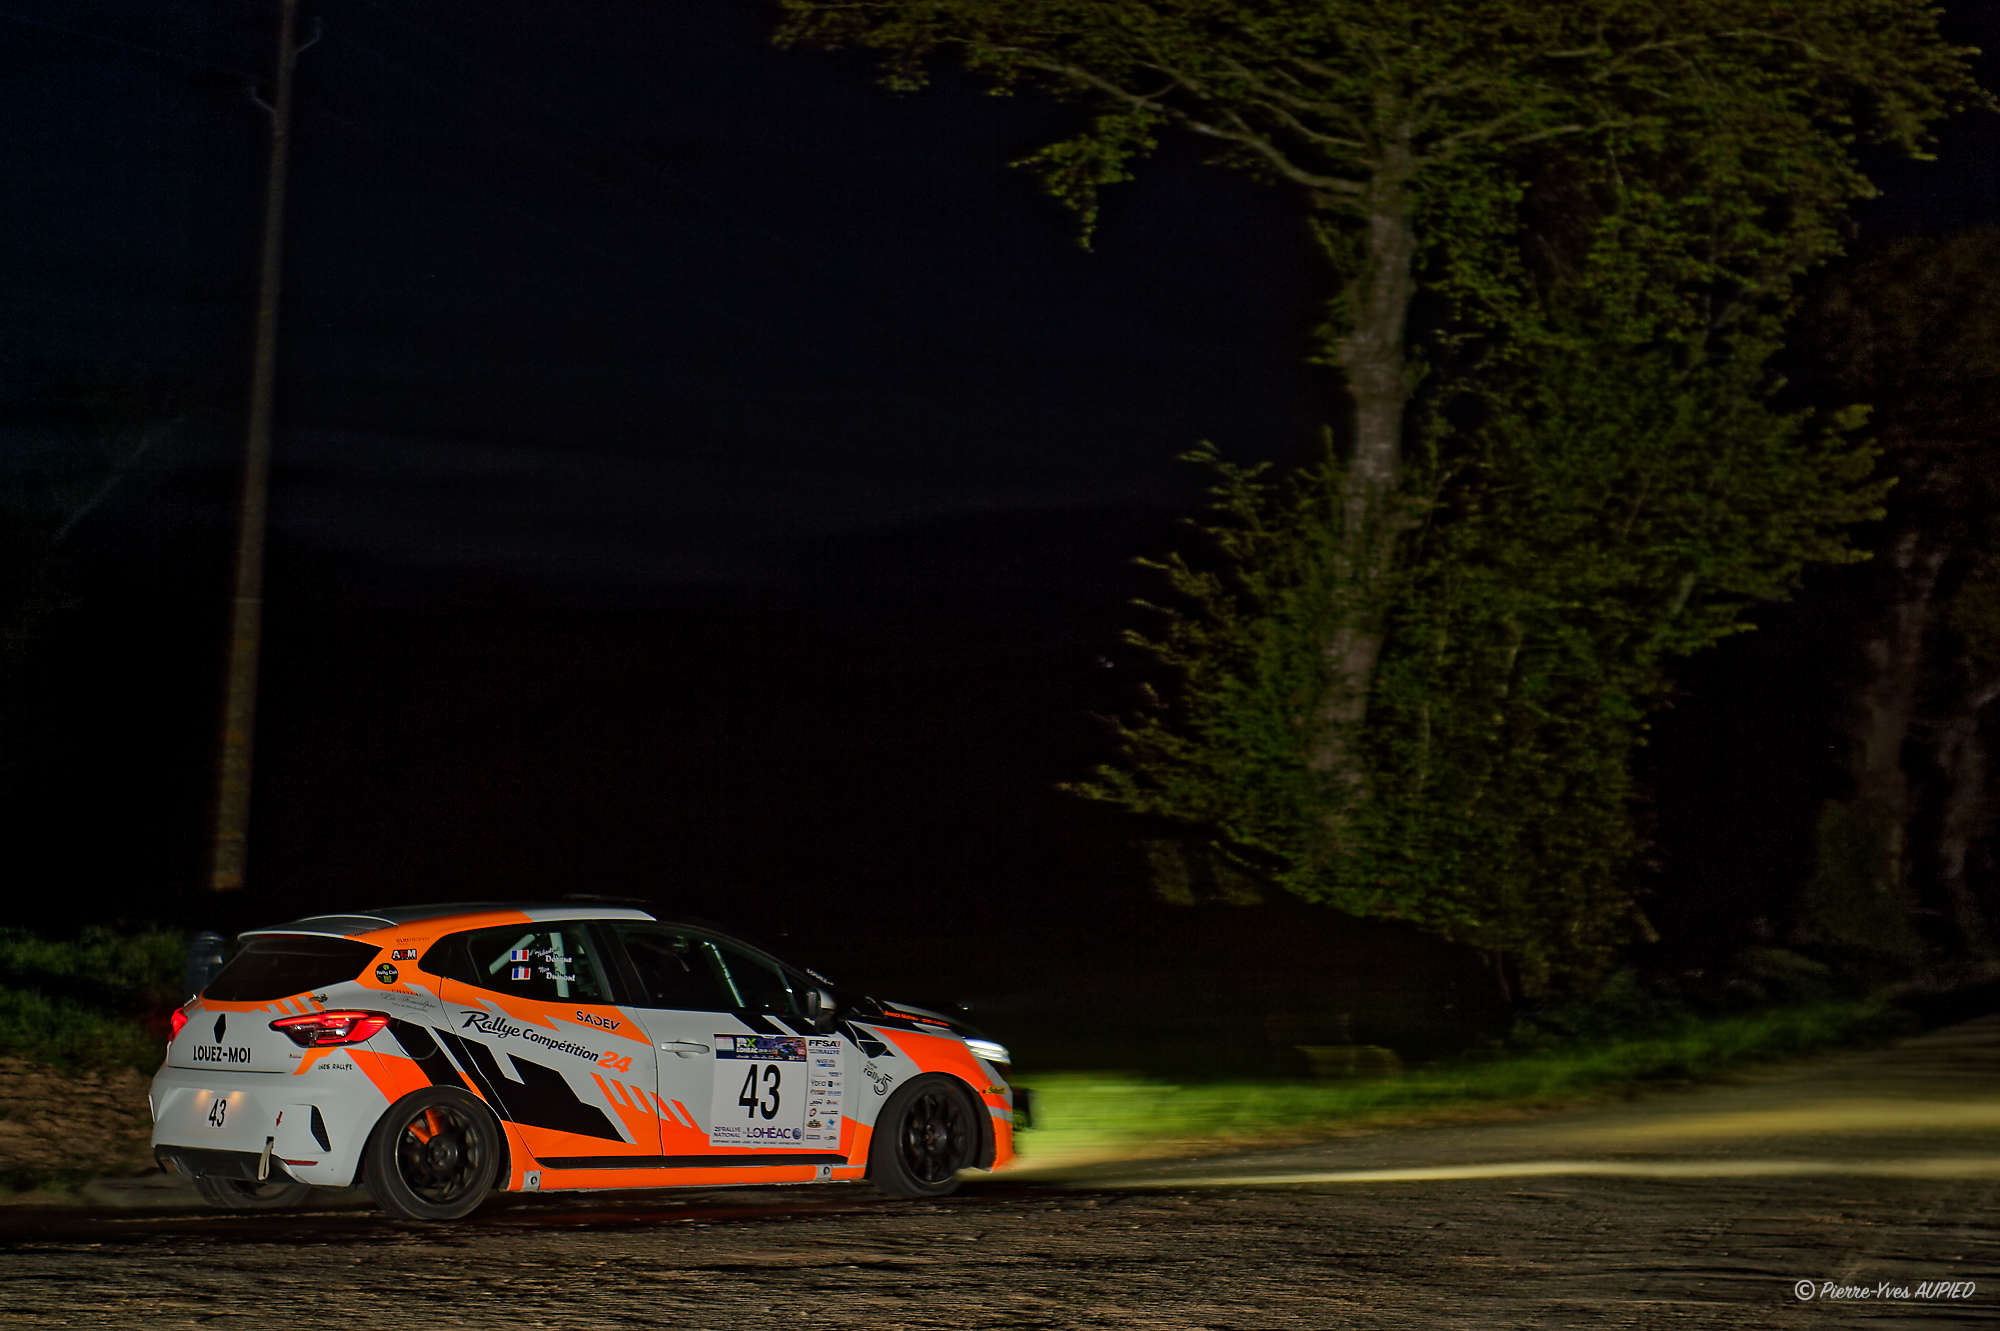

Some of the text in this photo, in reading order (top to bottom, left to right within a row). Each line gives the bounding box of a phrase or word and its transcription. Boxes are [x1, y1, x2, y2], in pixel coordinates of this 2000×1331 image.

[576, 1010, 621, 1031] SADEV
[460, 1010, 633, 1074] Rallye Compétition 24
[808, 1039, 837, 1047] FFSA
[193, 1046, 251, 1063] LOUEZ-MOI
[738, 1063, 781, 1120] 43
[208, 1098, 227, 1128] 43
[746, 1125, 791, 1139] LOHÉAC
